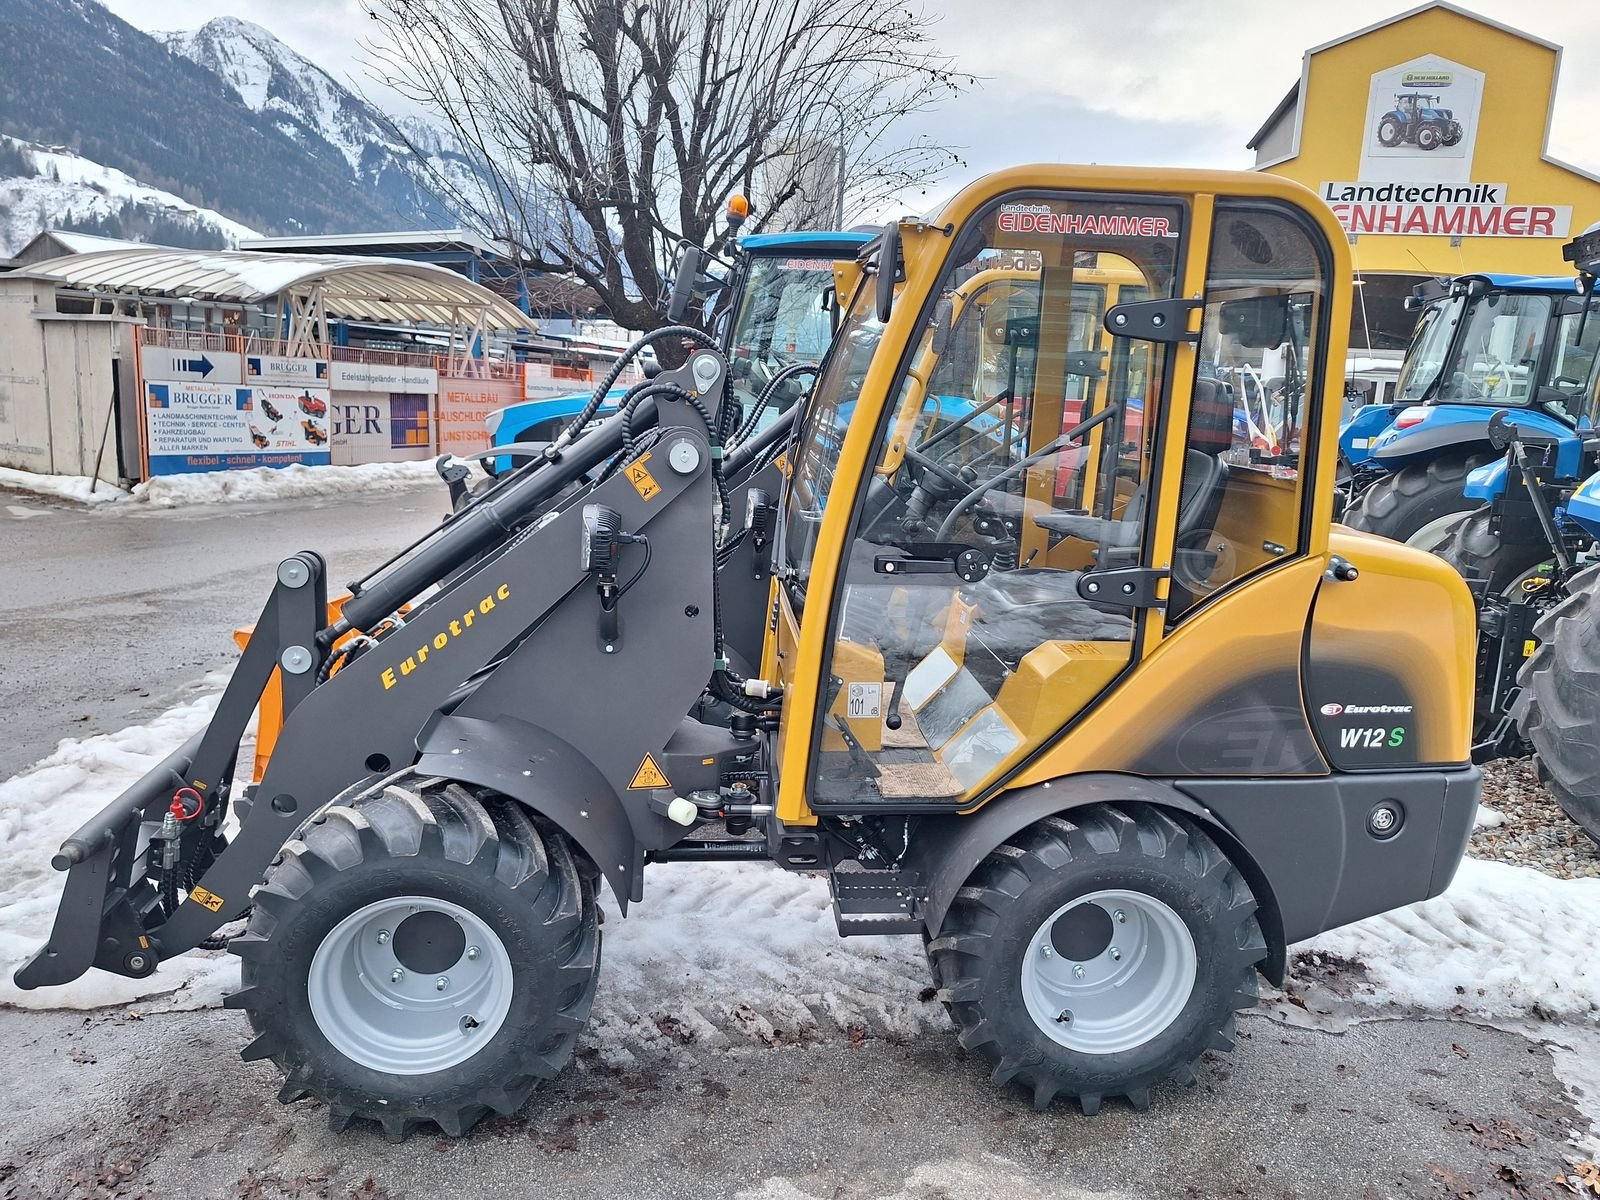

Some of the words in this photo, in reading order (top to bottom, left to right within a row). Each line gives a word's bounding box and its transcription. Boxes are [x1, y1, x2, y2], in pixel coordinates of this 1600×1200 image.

[1326, 183, 1498, 203] Landtechnik
[1001, 204, 1050, 213] Landtechnik
[999, 213, 1169, 236] EIDENHAMMER
[270, 362, 308, 372] BRUGGER
[341, 372, 397, 384] Edelstahlgeländer
[401, 375, 430, 385] Handläufe
[173, 392, 233, 405] BRUGGER
[447, 392, 498, 403] METALLBAU
[188, 456, 219, 465] flexibel
[226, 455, 256, 464] schnell
[262, 454, 303, 465] kompetent
[380, 583, 511, 690] Eurotrac
[850, 698, 864, 715] 101
[871, 706, 878, 714] dB
[1344, 704, 1413, 714] Eurotrac
[1341, 728, 1386, 748] W12
[1388, 727, 1405, 747] S
